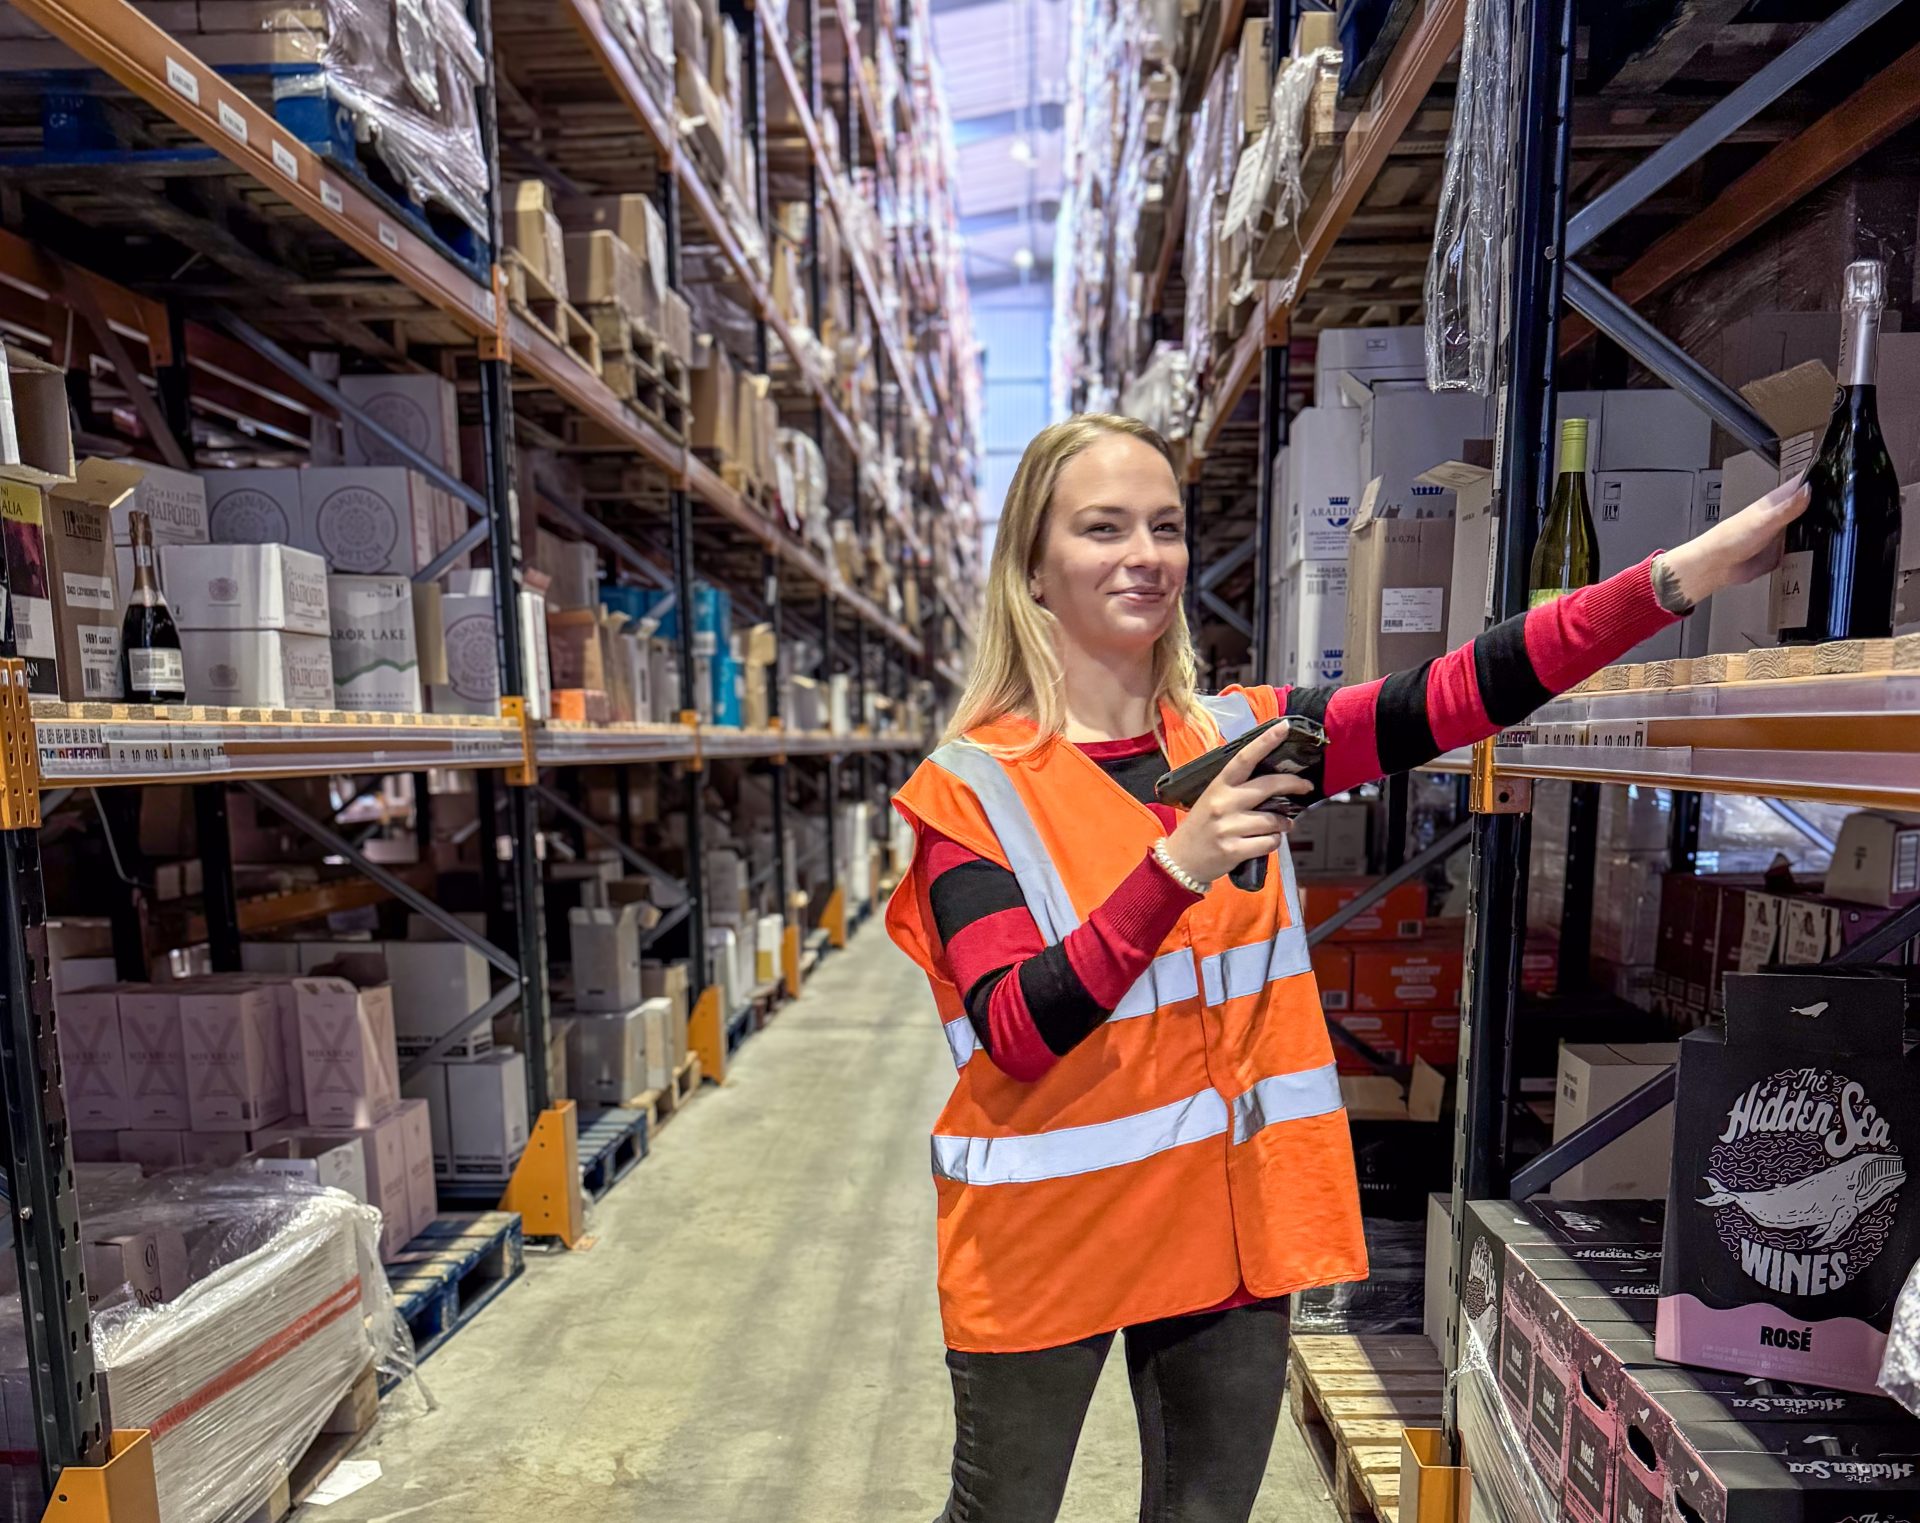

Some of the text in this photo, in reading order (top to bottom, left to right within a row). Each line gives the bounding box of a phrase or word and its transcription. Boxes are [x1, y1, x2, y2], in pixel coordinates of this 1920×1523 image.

[222, 495, 275, 514] SKINNY
[330, 492, 384, 514] SKINNY
[371, 629, 406, 641] LAKE
[1793, 1067, 1828, 1092] The
[1719, 1081, 1891, 1158] Hidden Sea
[1573, 1249, 1634, 1259] Hidden
[1740, 1237, 1848, 1297] WINES
[1760, 1325, 1813, 1353] ROSÉ
[1731, 1398, 1847, 1413] Hidden Sea
[1783, 1407, 1808, 1415] The
[1786, 1460, 1915, 1480] Hidden Sea
[1845, 1474, 1873, 1484] The
